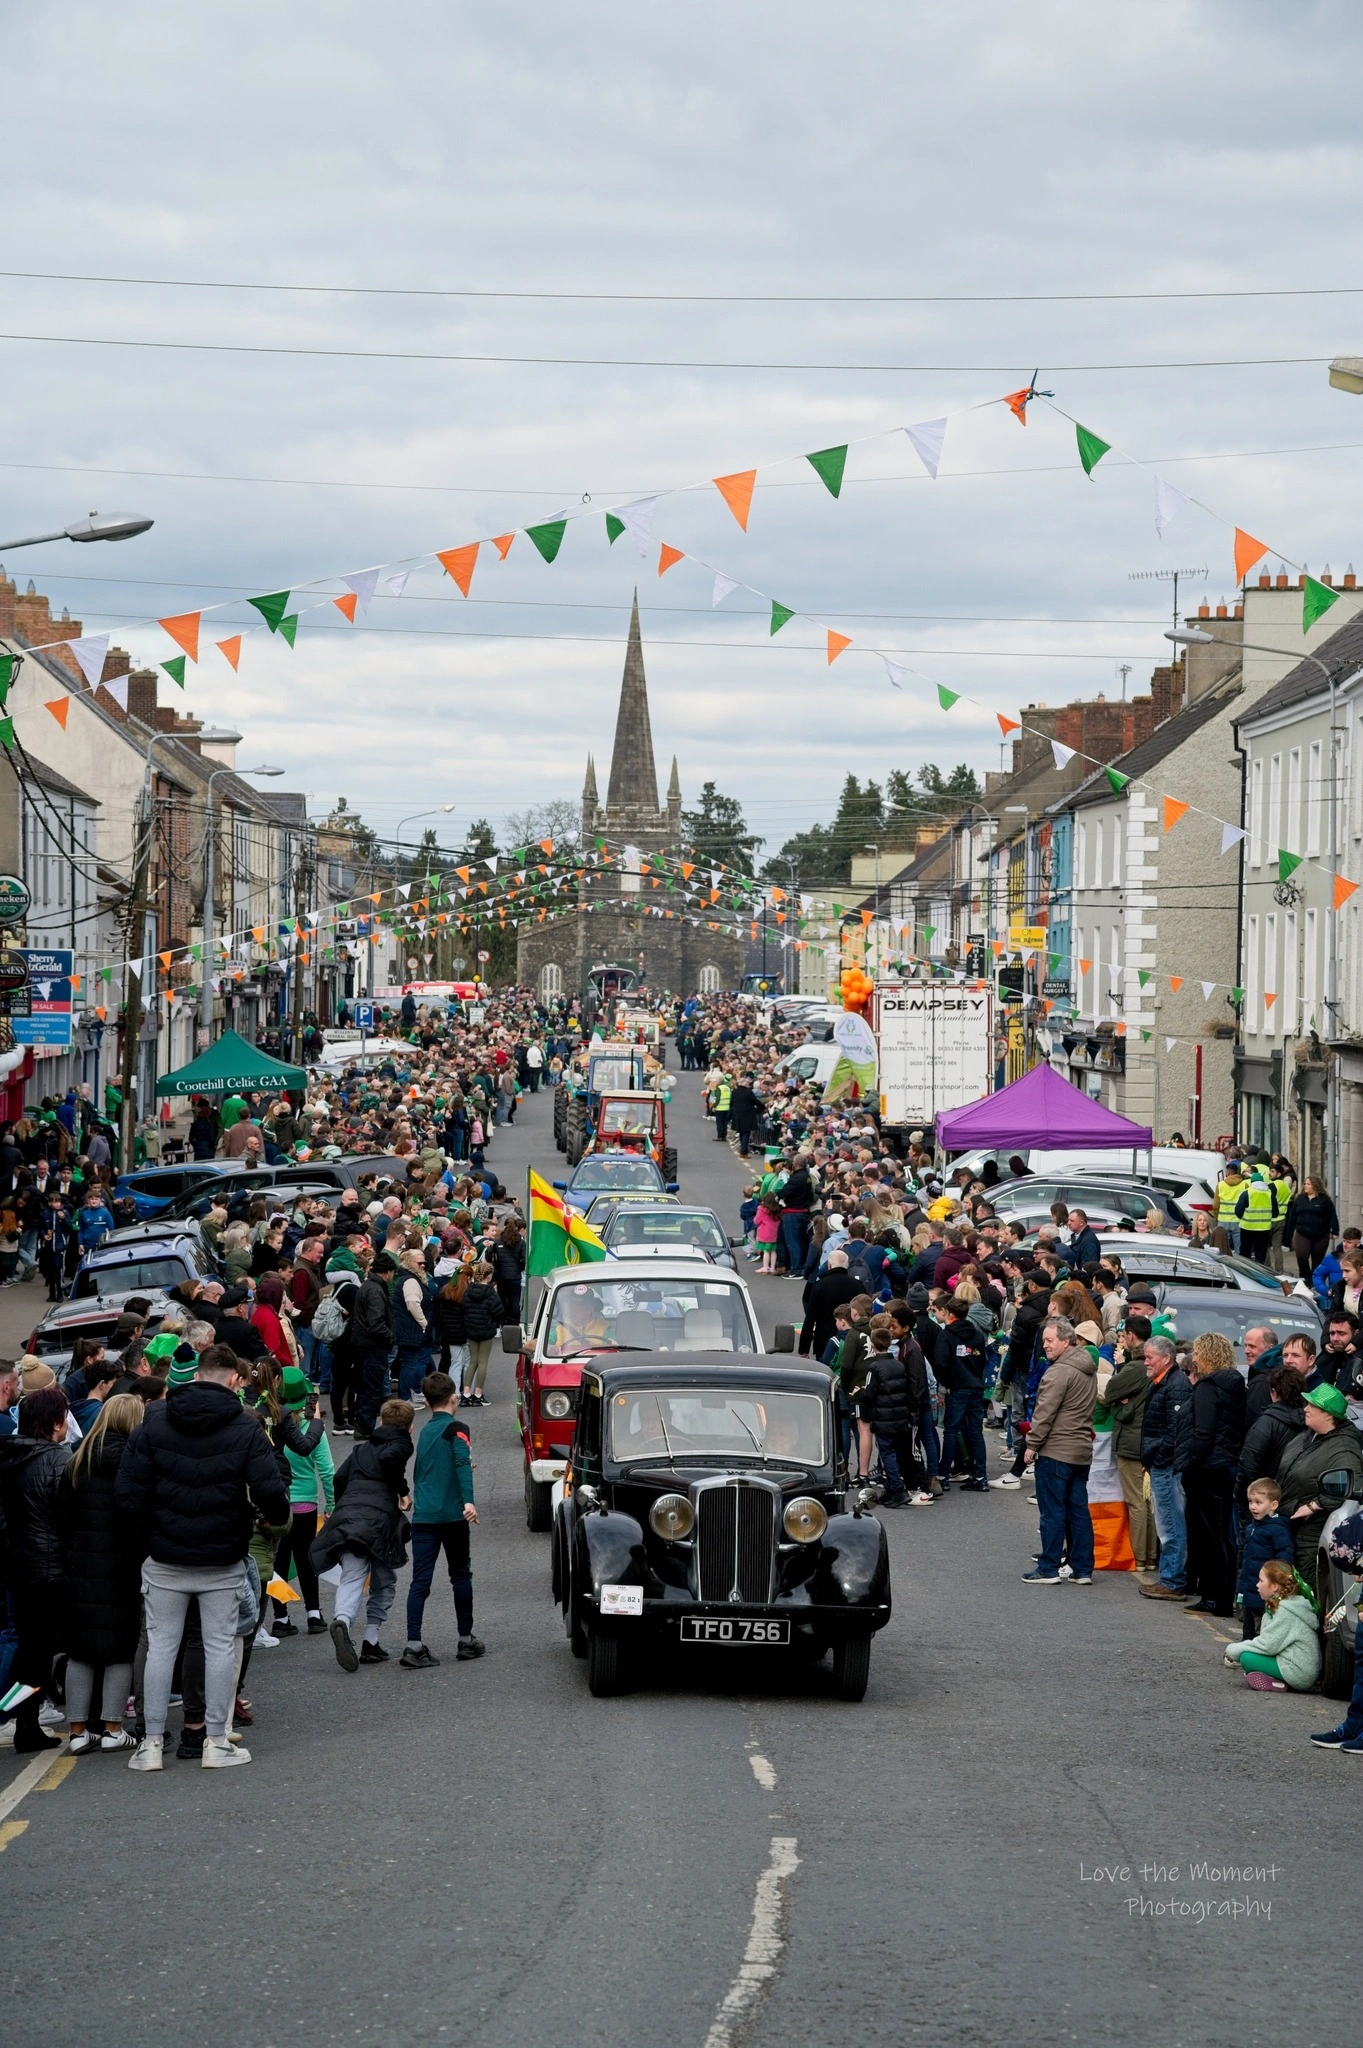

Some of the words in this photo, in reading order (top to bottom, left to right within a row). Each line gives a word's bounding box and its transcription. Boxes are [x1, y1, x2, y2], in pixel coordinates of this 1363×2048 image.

[28, 954, 55, 963] Sherry
[884, 1000, 984, 1010] DEMPSEY
[360, 1006, 370, 1019] P
[925, 1013, 984, 1021] International
[176, 1079, 224, 1091] Cootehill
[227, 1078, 256, 1088] Celtic
[260, 1076, 287, 1086] GAA
[739, 1622, 780, 1640] 756
